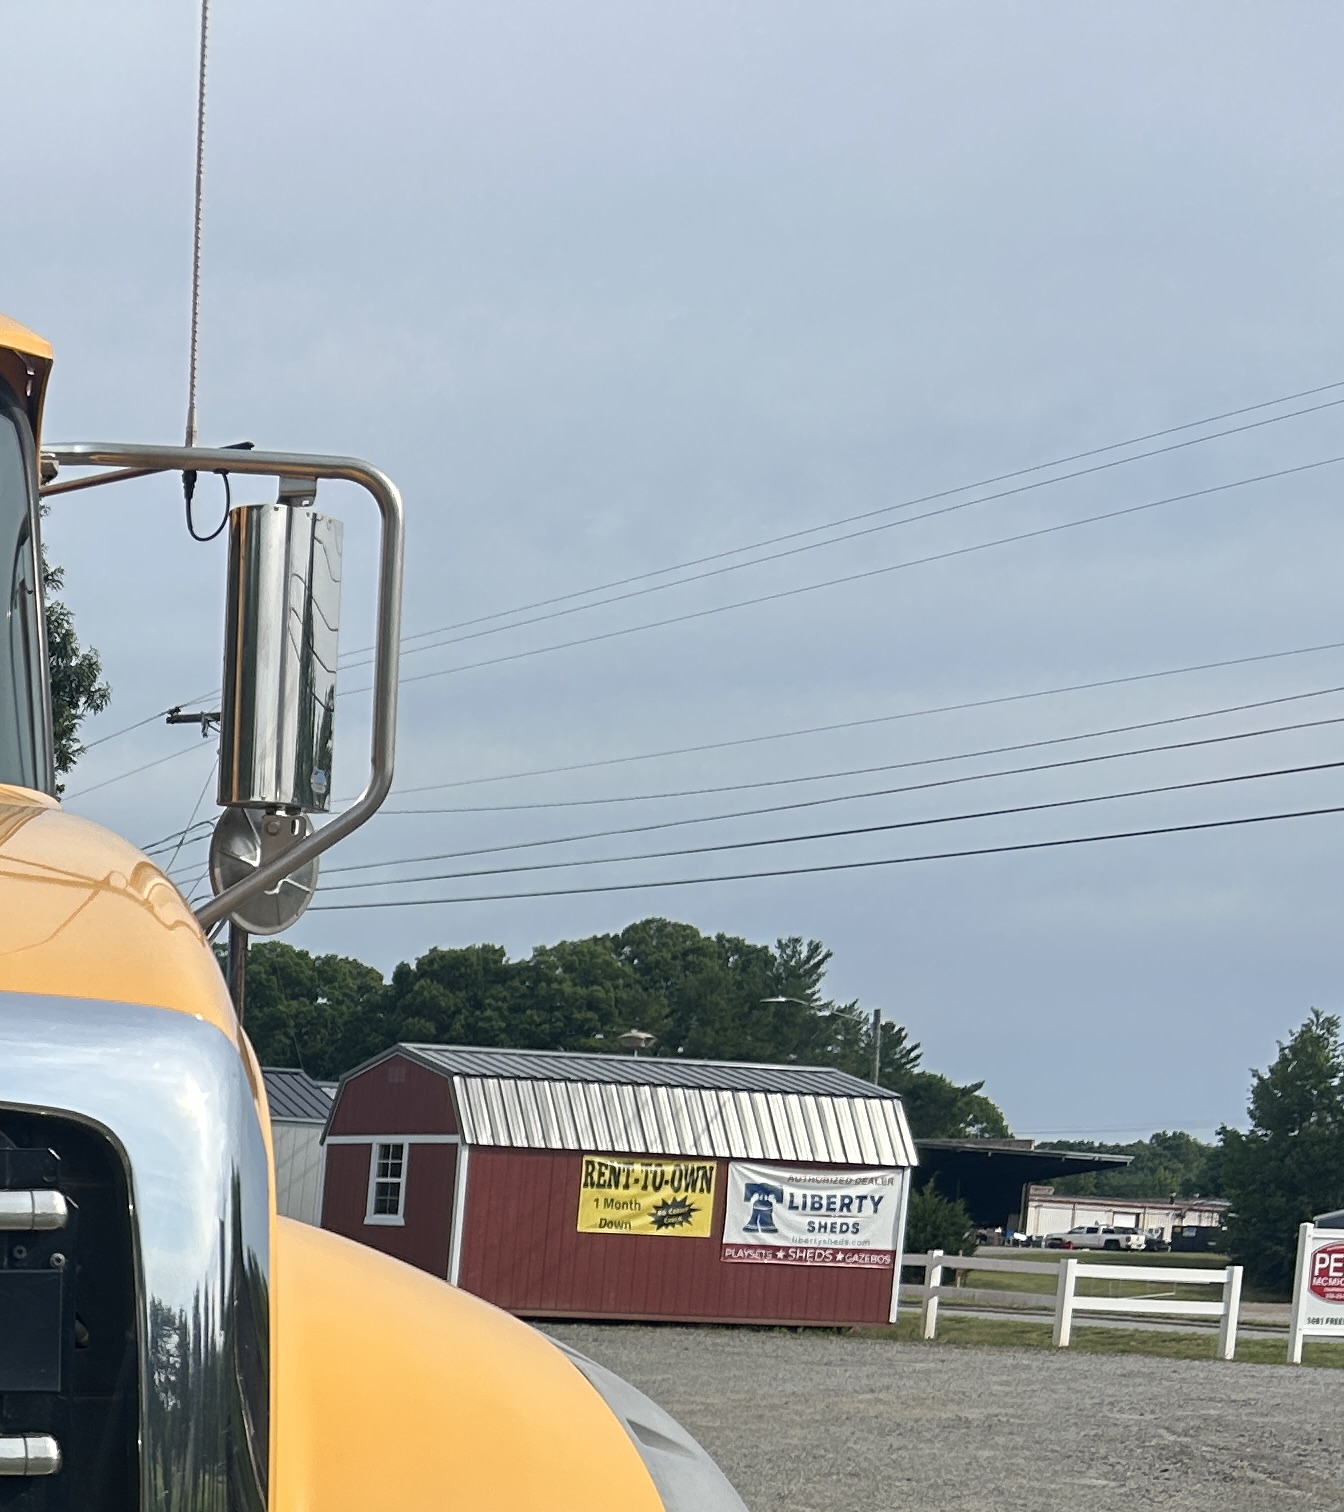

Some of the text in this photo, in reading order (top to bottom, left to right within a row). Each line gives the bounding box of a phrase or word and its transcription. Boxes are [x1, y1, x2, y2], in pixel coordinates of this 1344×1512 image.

[583, 1160, 714, 1194] RENT-TO-OWN
[594, 1198, 641, 1211] 1 Month
[788, 1192, 884, 1214] LIBERTY
[599, 1218, 632, 1230] Down
[807, 1220, 860, 1235] SHEDS
[791, 1236, 871, 1247] libertysheds.com
[724, 1247, 891, 1264] PLAYSETS SHEDS GAZEBOS
